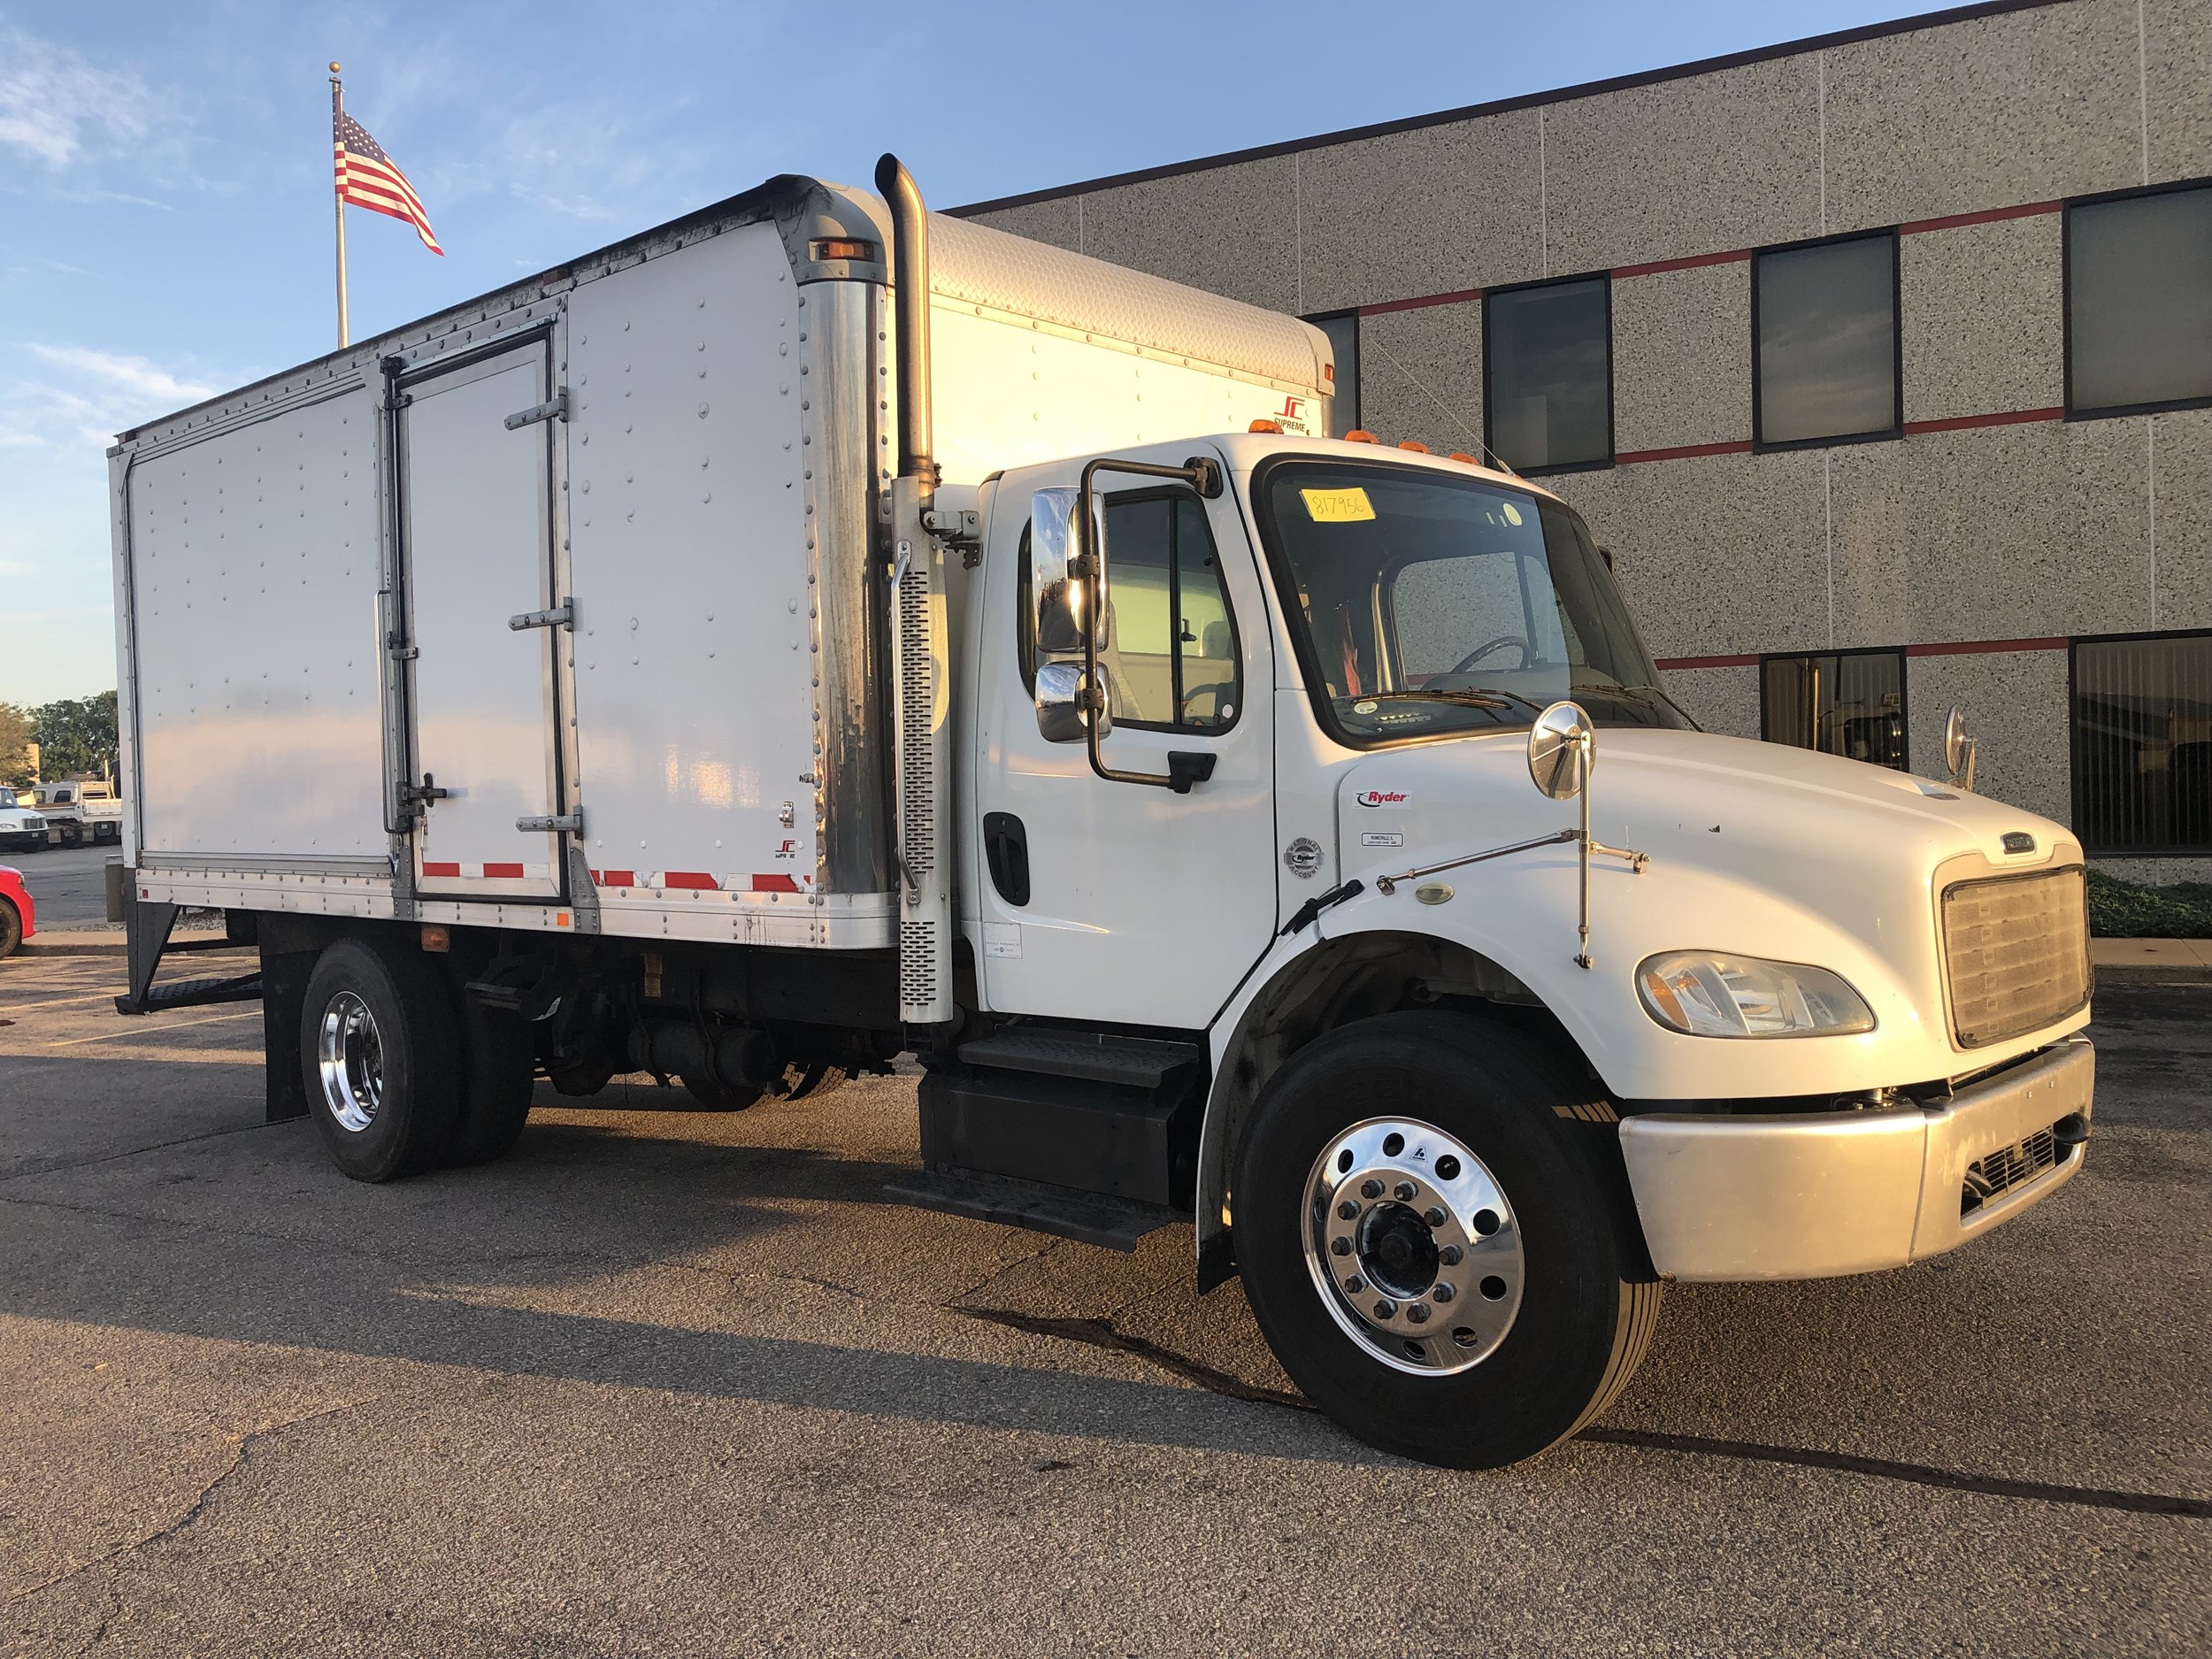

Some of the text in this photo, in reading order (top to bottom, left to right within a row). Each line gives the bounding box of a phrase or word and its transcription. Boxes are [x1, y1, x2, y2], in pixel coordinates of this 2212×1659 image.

[1274, 418, 1305, 432] SUPREME
[1311, 495, 1365, 515] 817956
[1368, 791, 1407, 803] Ryder
[1289, 838, 1319, 852] NATIONAL
[1290, 865, 1318, 878] ACCOUNT
